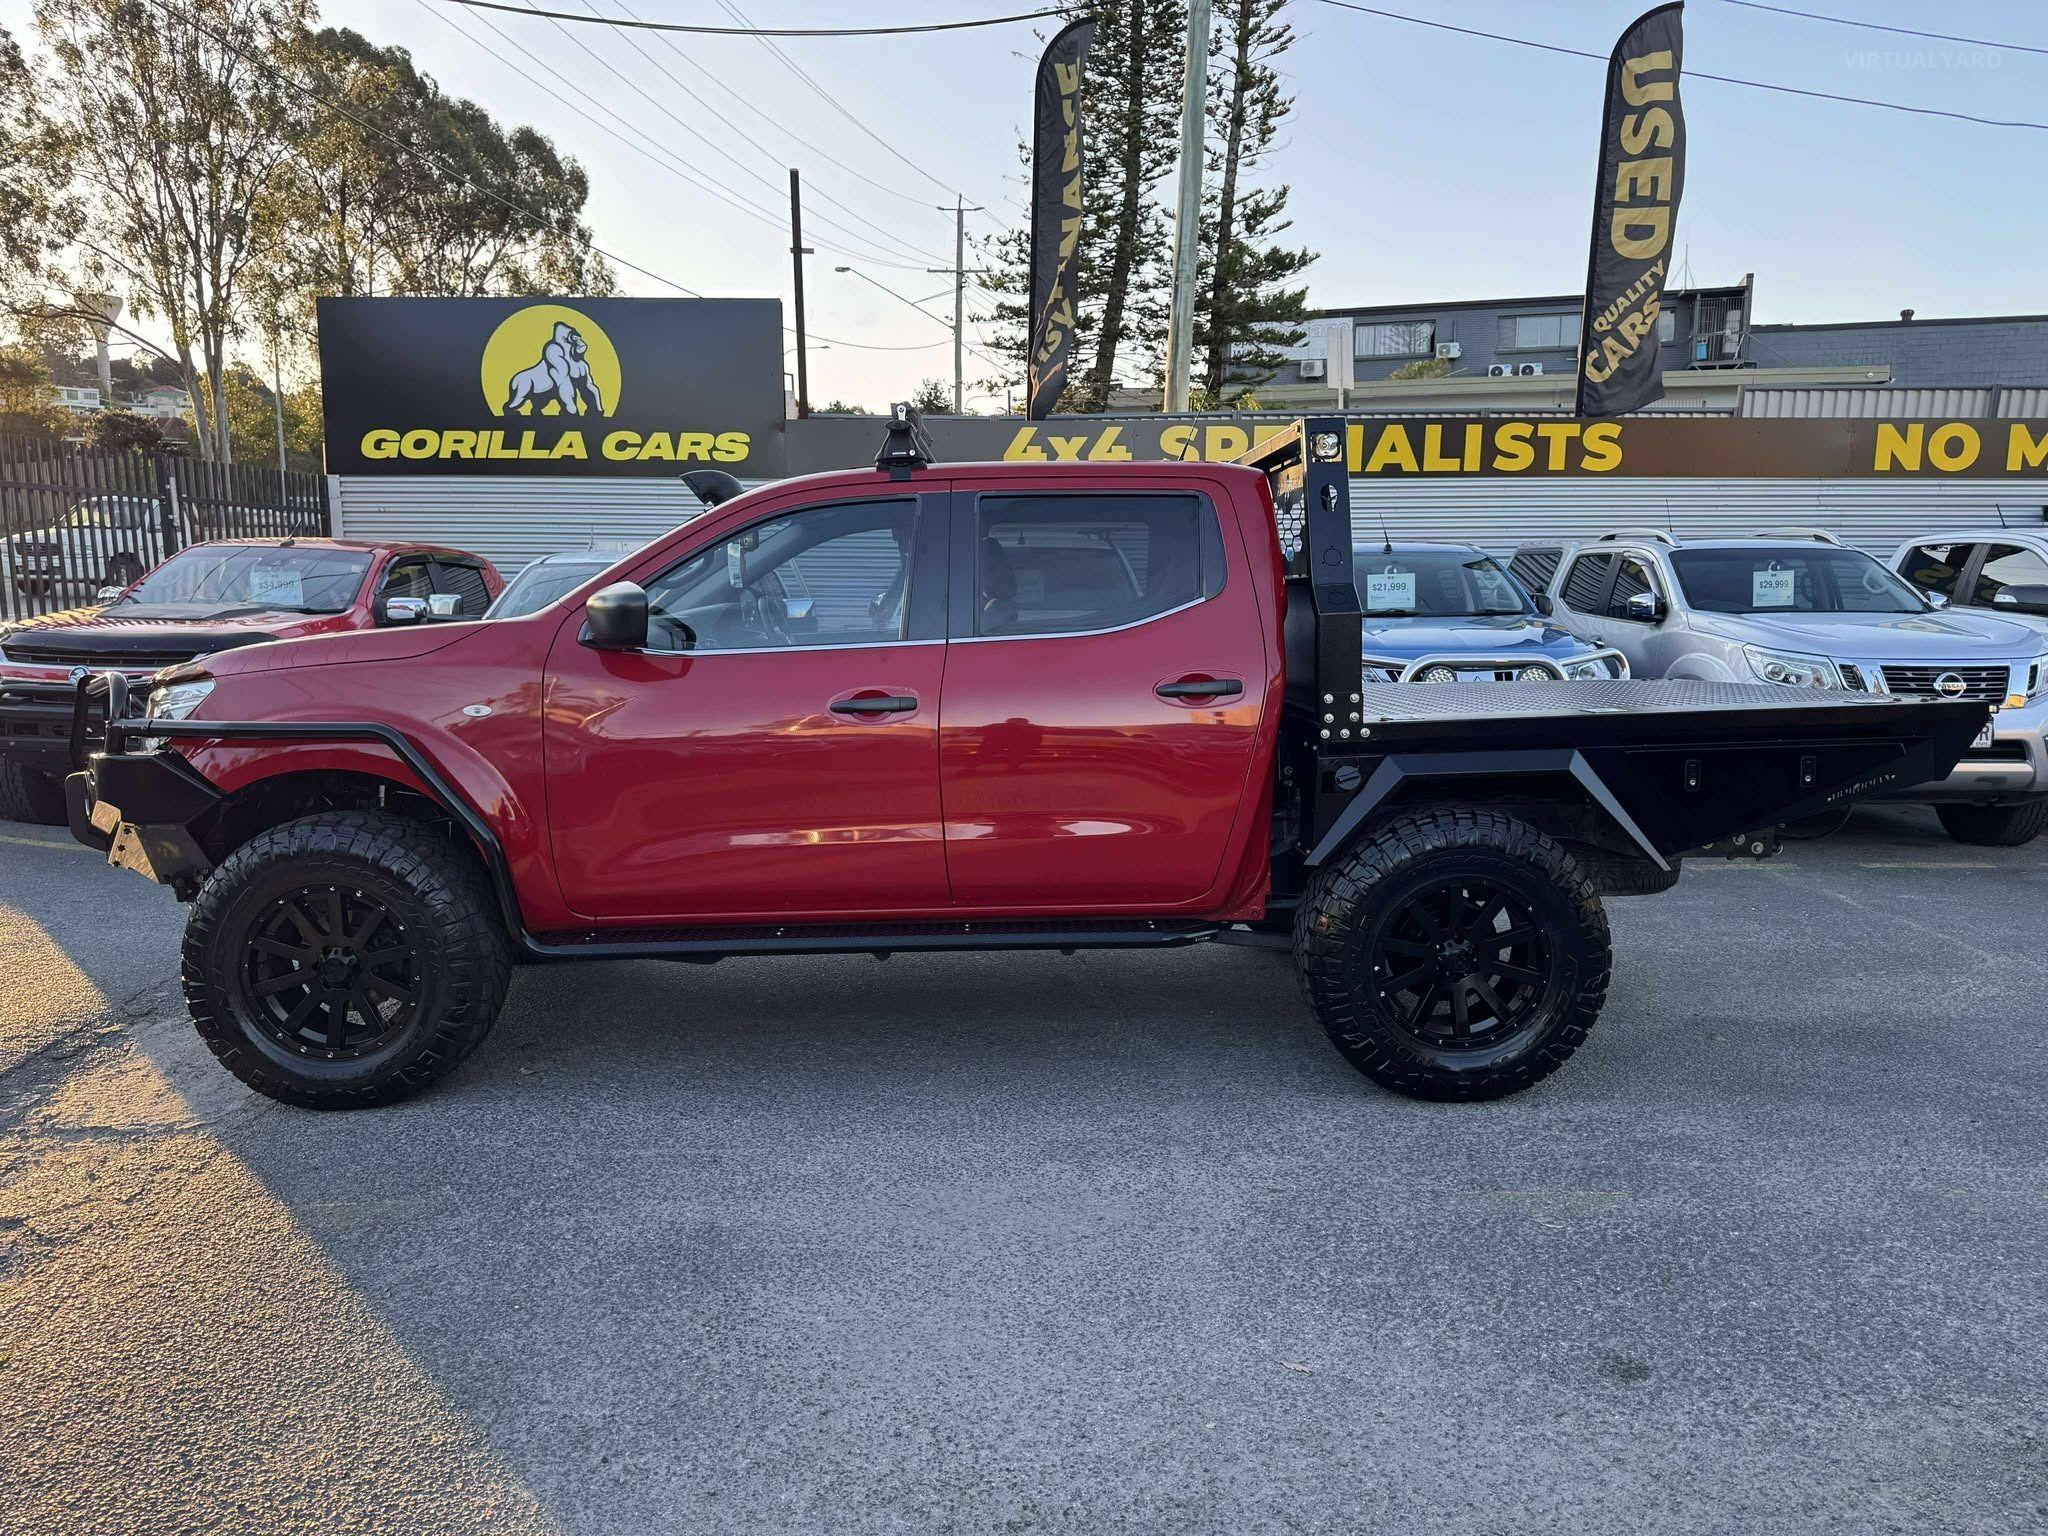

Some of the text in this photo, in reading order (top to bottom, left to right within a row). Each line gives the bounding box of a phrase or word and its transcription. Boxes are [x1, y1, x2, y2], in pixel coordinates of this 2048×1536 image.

[1611, 50, 1675, 259] USED
[1593, 259, 1665, 333] QUALITY
[1585, 290, 1661, 383] CARS
[360, 429, 751, 462] GORILLA CARS
[1003, 422, 1623, 472] 4x4 SPIALISTS
[1874, 423, 1981, 472] NO
